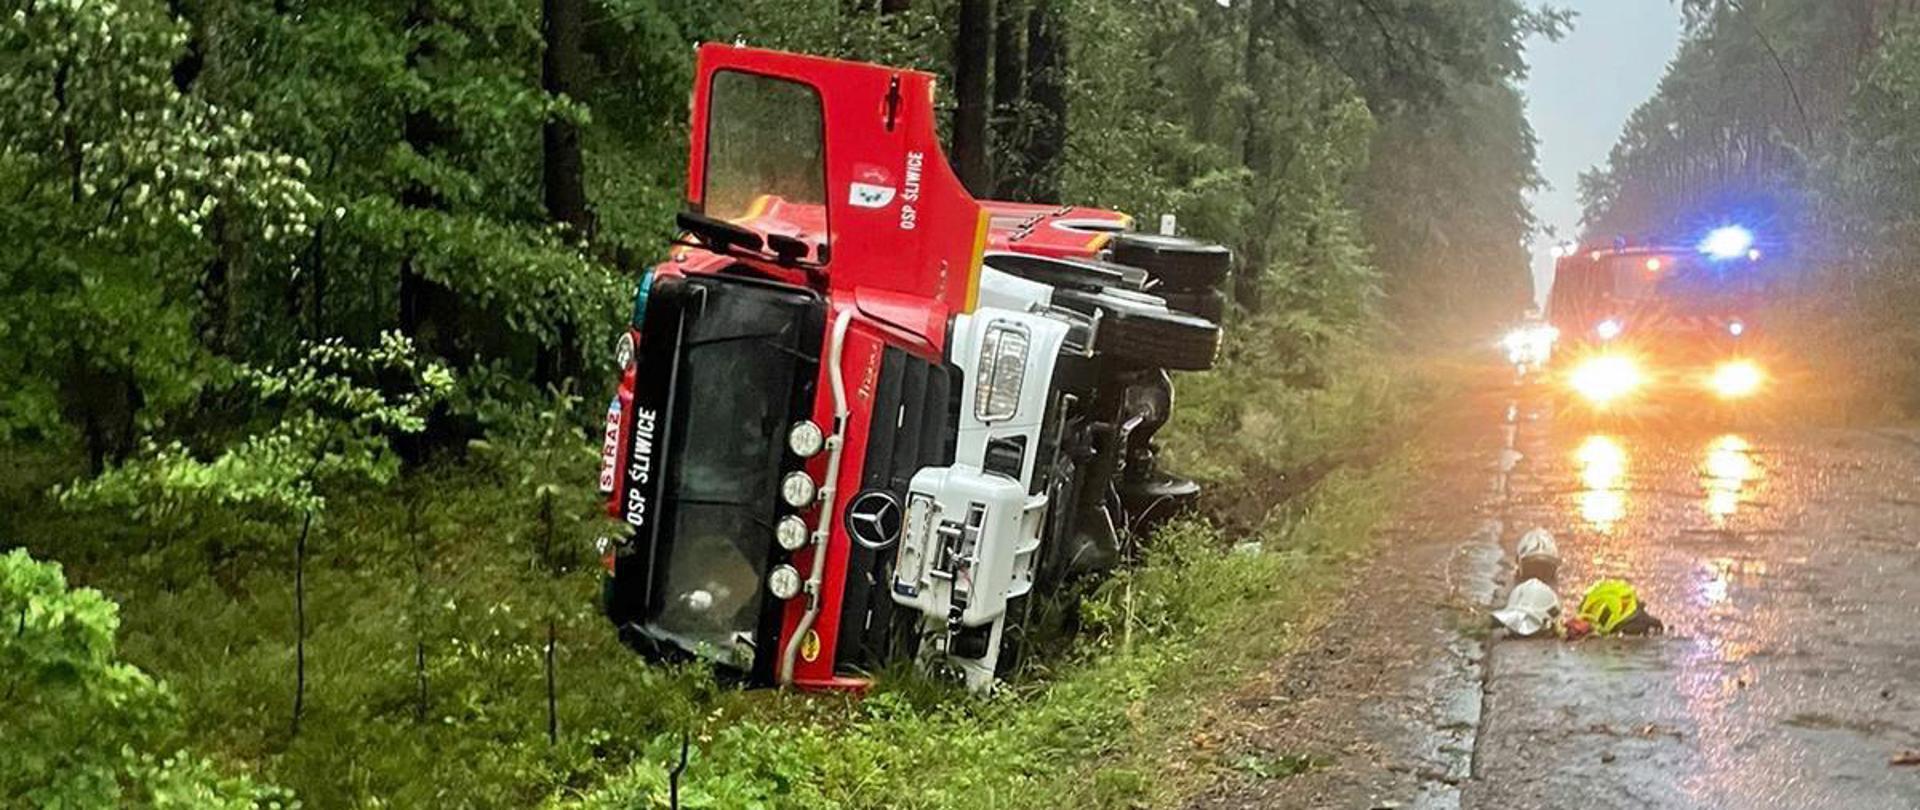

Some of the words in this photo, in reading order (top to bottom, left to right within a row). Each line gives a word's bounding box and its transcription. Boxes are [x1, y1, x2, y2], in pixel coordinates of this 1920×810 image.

[900, 151, 922, 201] ŚLIWICE
[900, 205, 916, 230] OSP
[628, 406, 656, 483] ŚLIWICE
[626, 488, 646, 526] OSP
